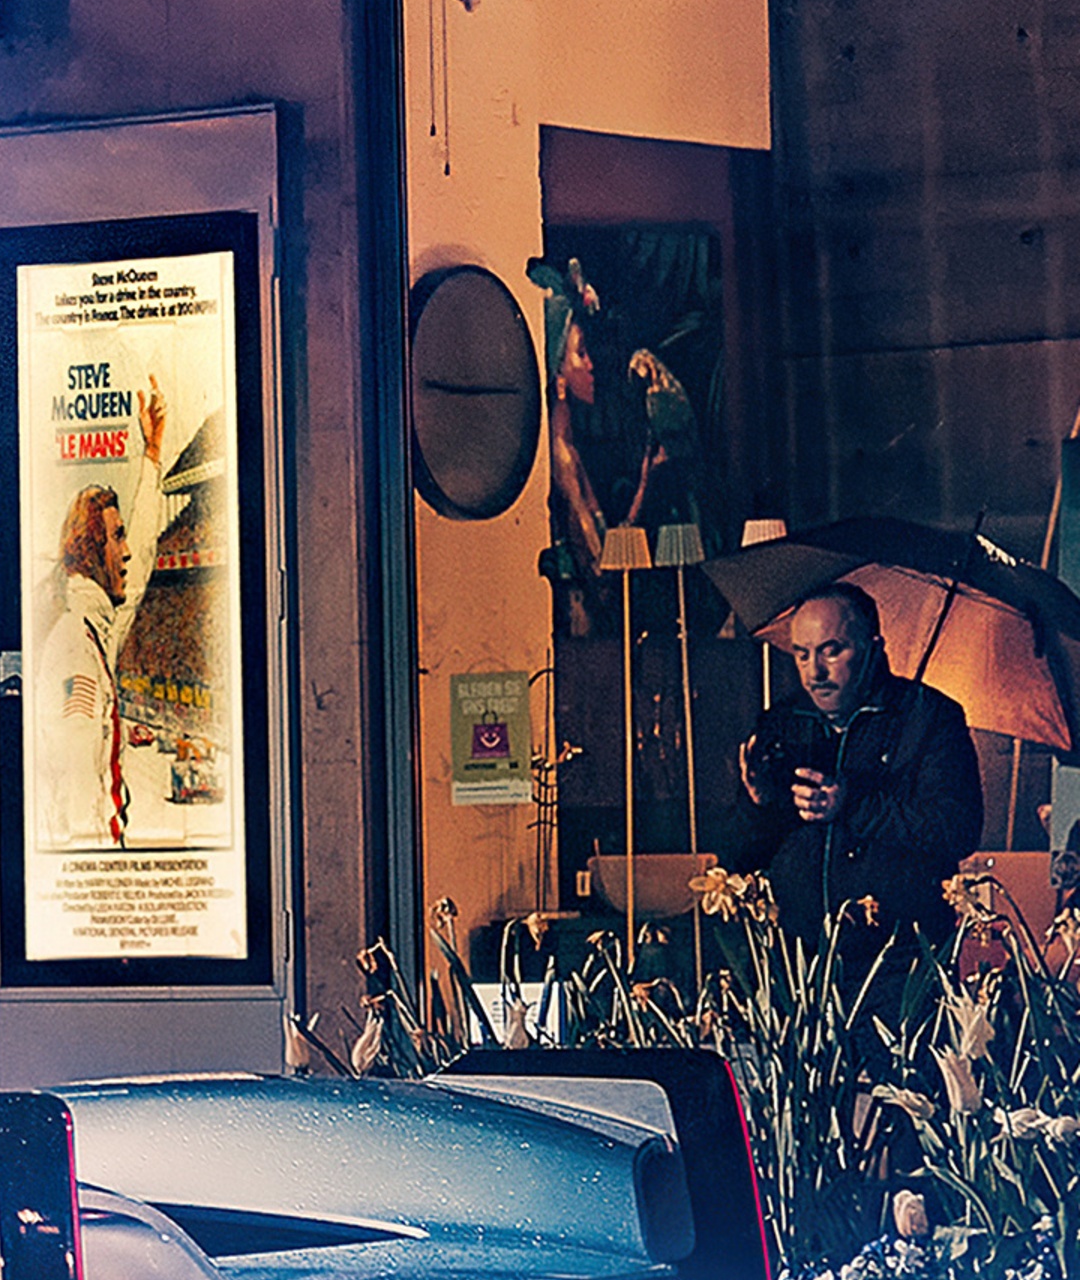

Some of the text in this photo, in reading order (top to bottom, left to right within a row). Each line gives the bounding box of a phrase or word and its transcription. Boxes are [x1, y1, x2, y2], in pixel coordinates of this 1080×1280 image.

[117, 269, 158, 284] McQueen
[68, 362, 110, 390] STEVE
[51, 390, 132, 421] McQUEEN
